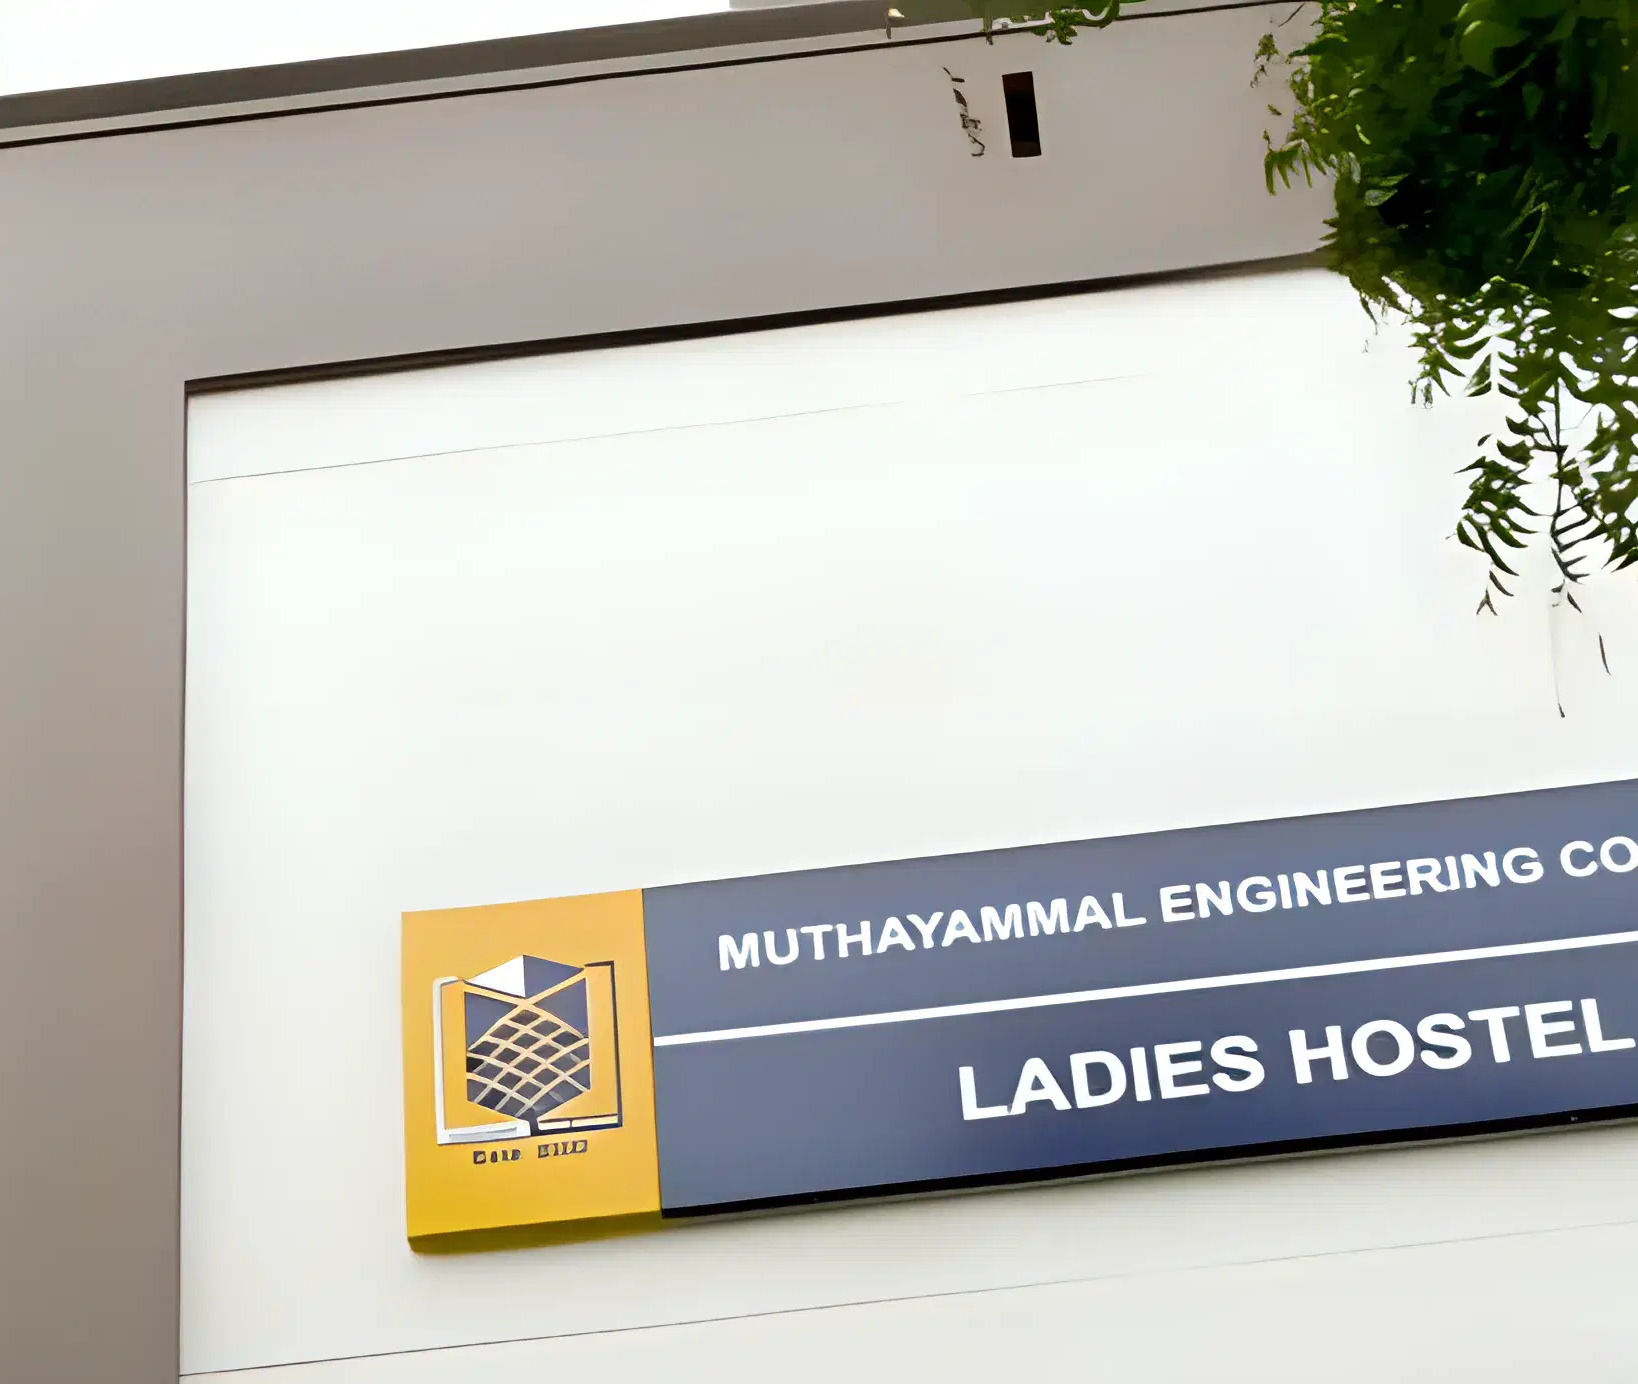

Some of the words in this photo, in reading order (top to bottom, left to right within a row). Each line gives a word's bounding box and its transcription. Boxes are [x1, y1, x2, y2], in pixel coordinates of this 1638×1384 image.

[717, 891, 1148, 972] MUTHAYAMMAL
[1158, 846, 1546, 924] ENGINEERING
[957, 1034, 1266, 1122] LADIES
[1287, 997, 1637, 1085] HOSTEL
